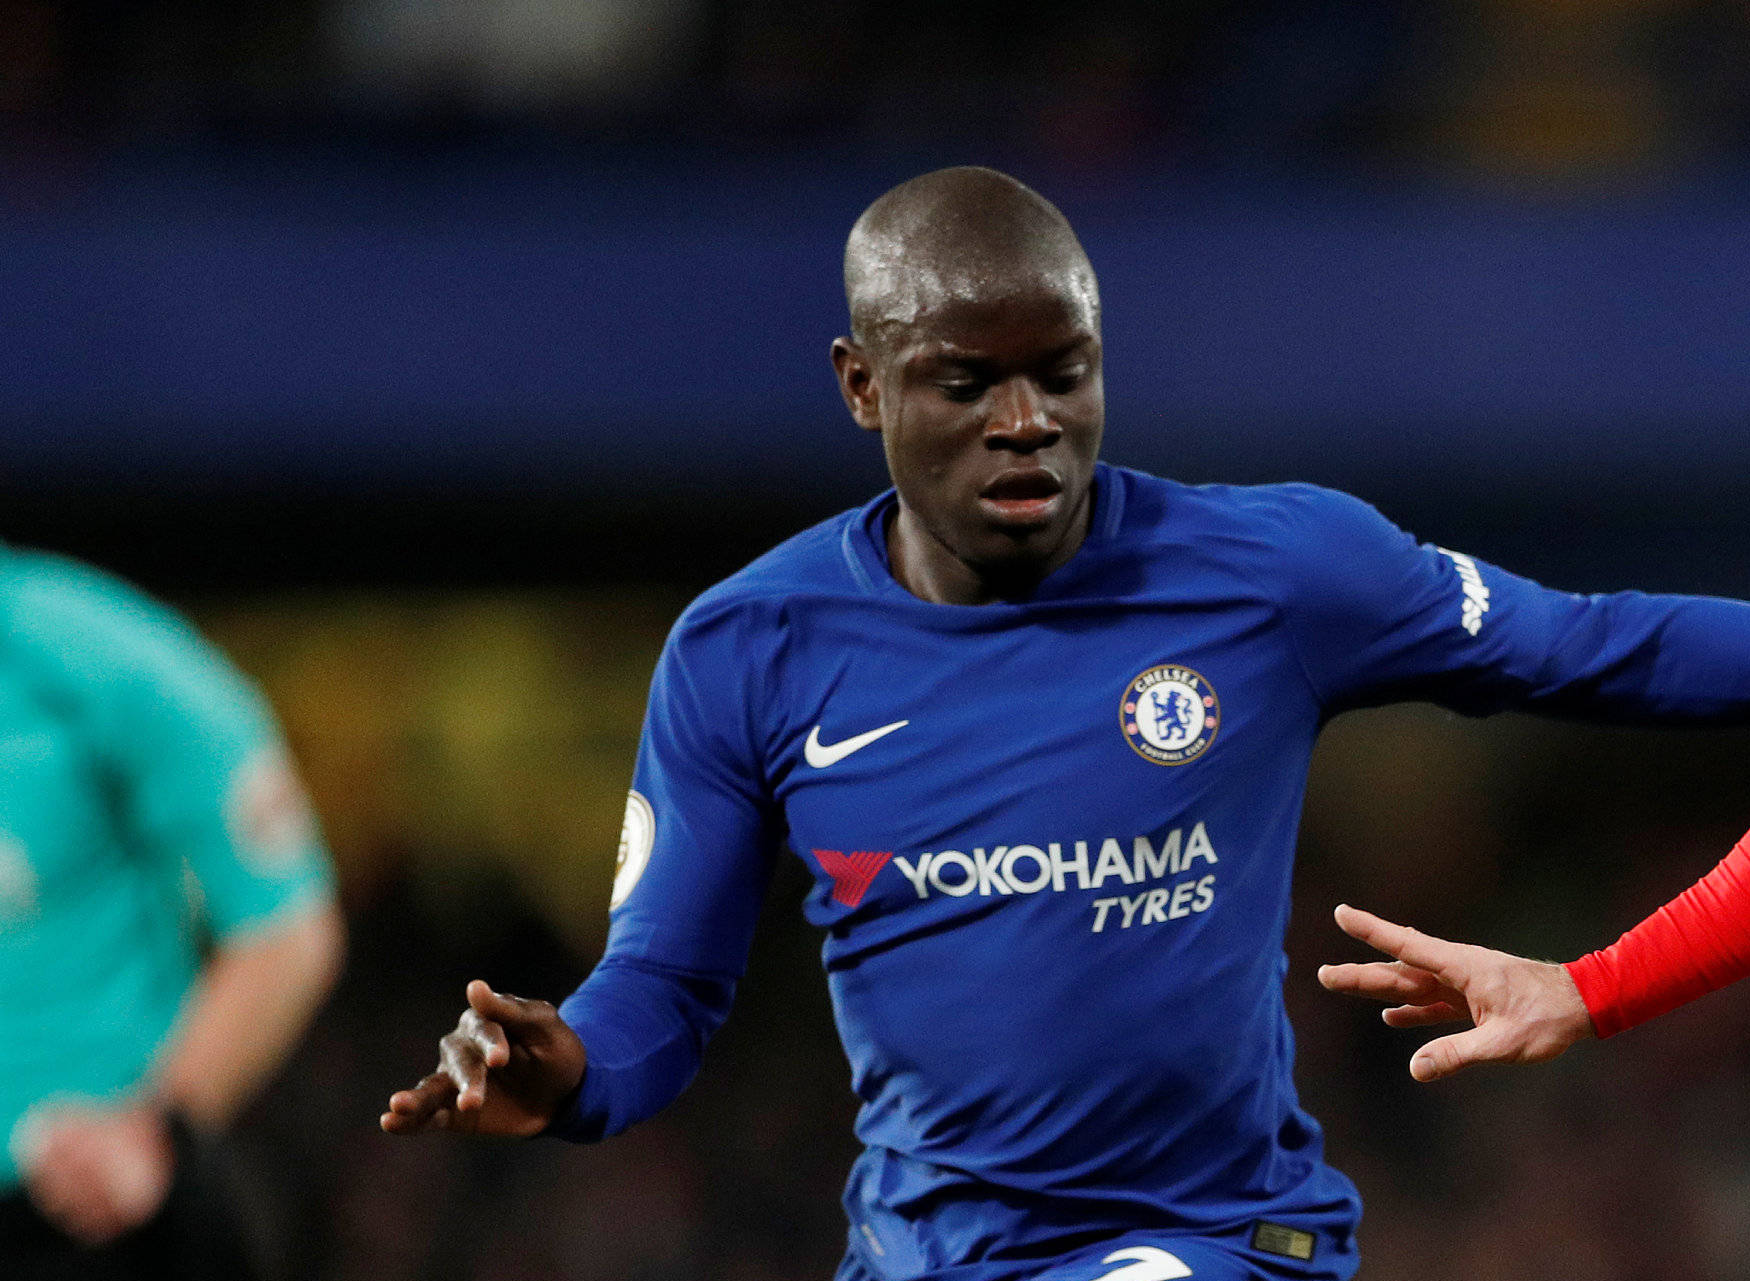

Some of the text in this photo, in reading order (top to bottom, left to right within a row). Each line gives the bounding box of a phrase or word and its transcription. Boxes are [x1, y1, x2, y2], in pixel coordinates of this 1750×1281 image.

[1135, 668, 1199, 693] CHELSEA
[893, 821, 1218, 899] YOKOHAMA
[1092, 875, 1215, 932] TYRES
